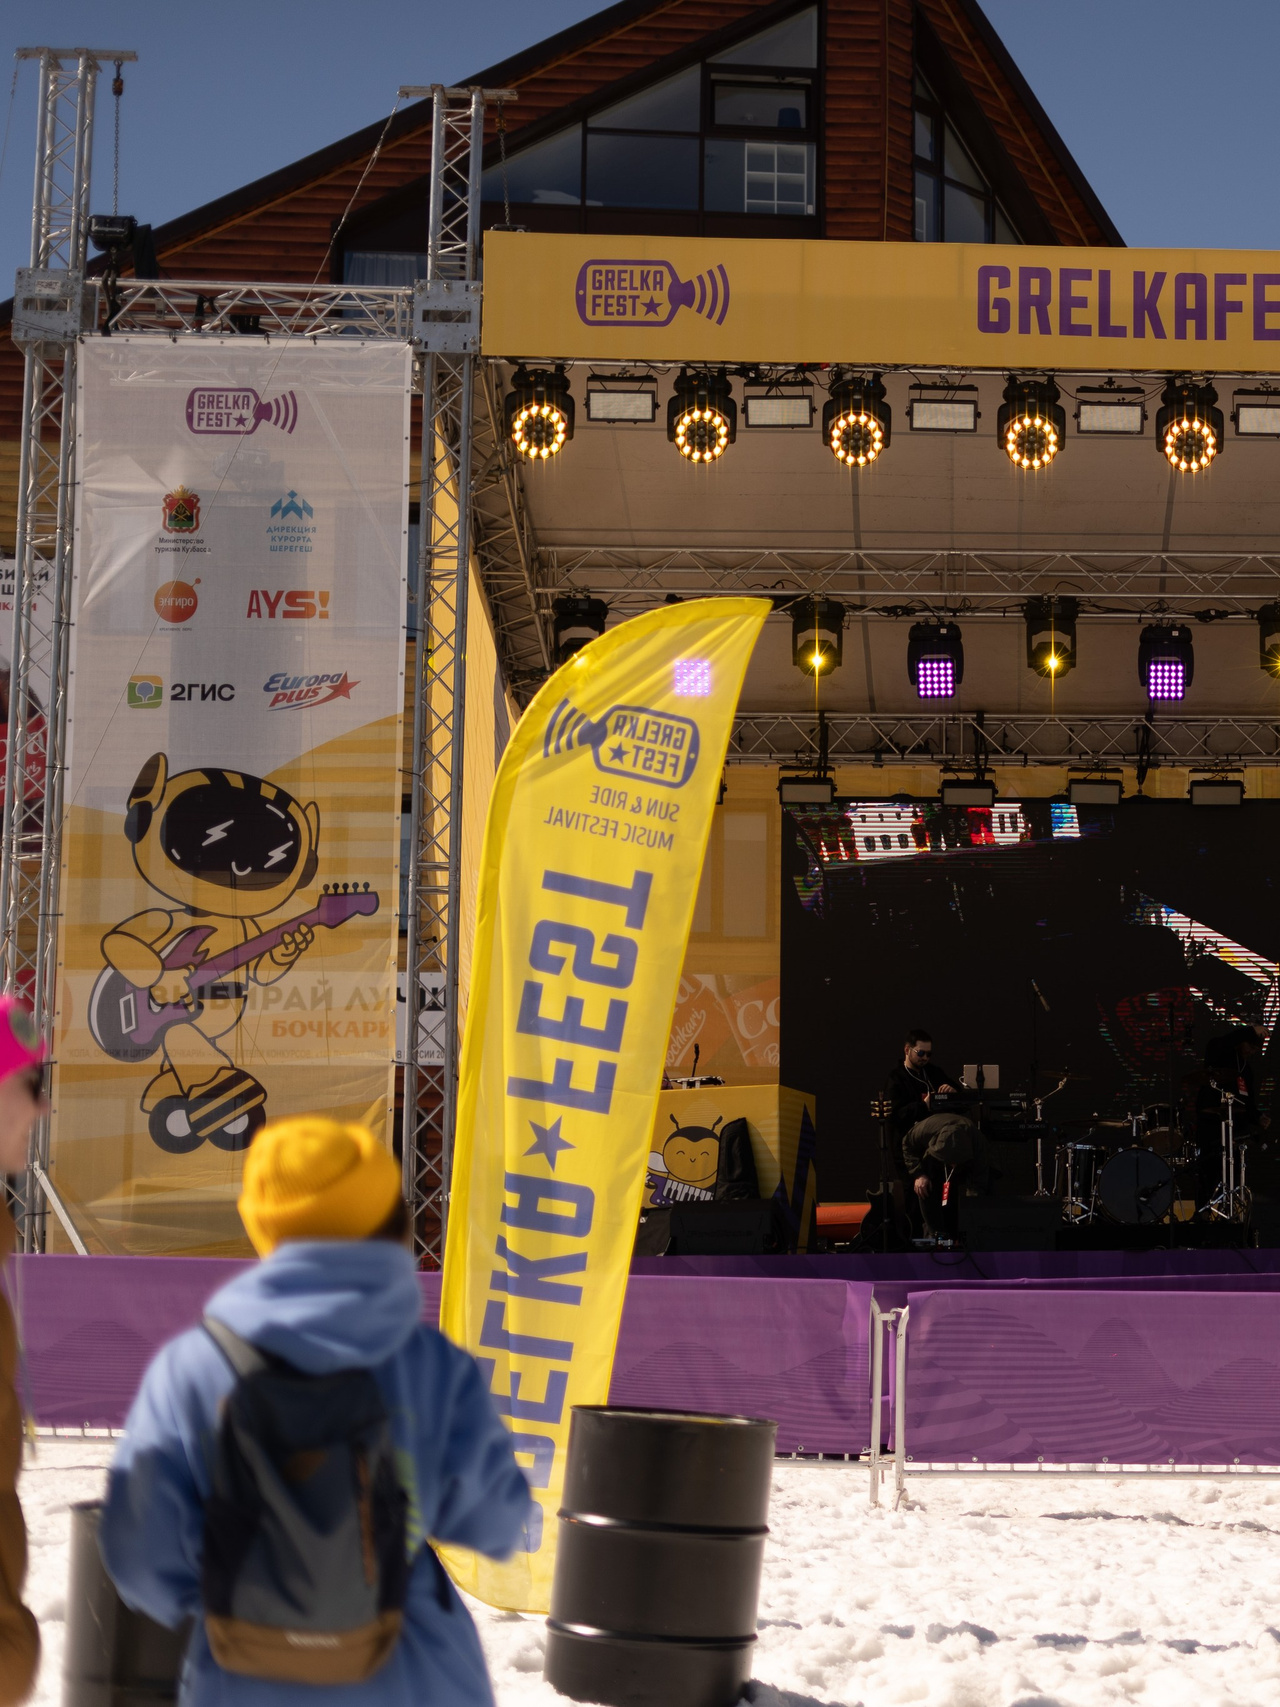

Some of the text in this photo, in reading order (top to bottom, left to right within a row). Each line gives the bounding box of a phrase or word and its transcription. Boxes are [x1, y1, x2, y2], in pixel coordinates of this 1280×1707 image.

[591, 268, 664, 293] GRELKA
[591, 293, 640, 317] FEST
[197, 393, 250, 411] GRELKA
[197, 411, 233, 428] FEST
[266, 526, 317, 535] ДИРЕКЦИЯ
[270, 535, 312, 544] КУРОРТА
[269, 545, 313, 553] ШЕРЕГЕШ
[246, 589, 331, 620] AYS!
[170, 682, 236, 702] 2ГИС
[664, 1007, 704, 1067] ochkari
